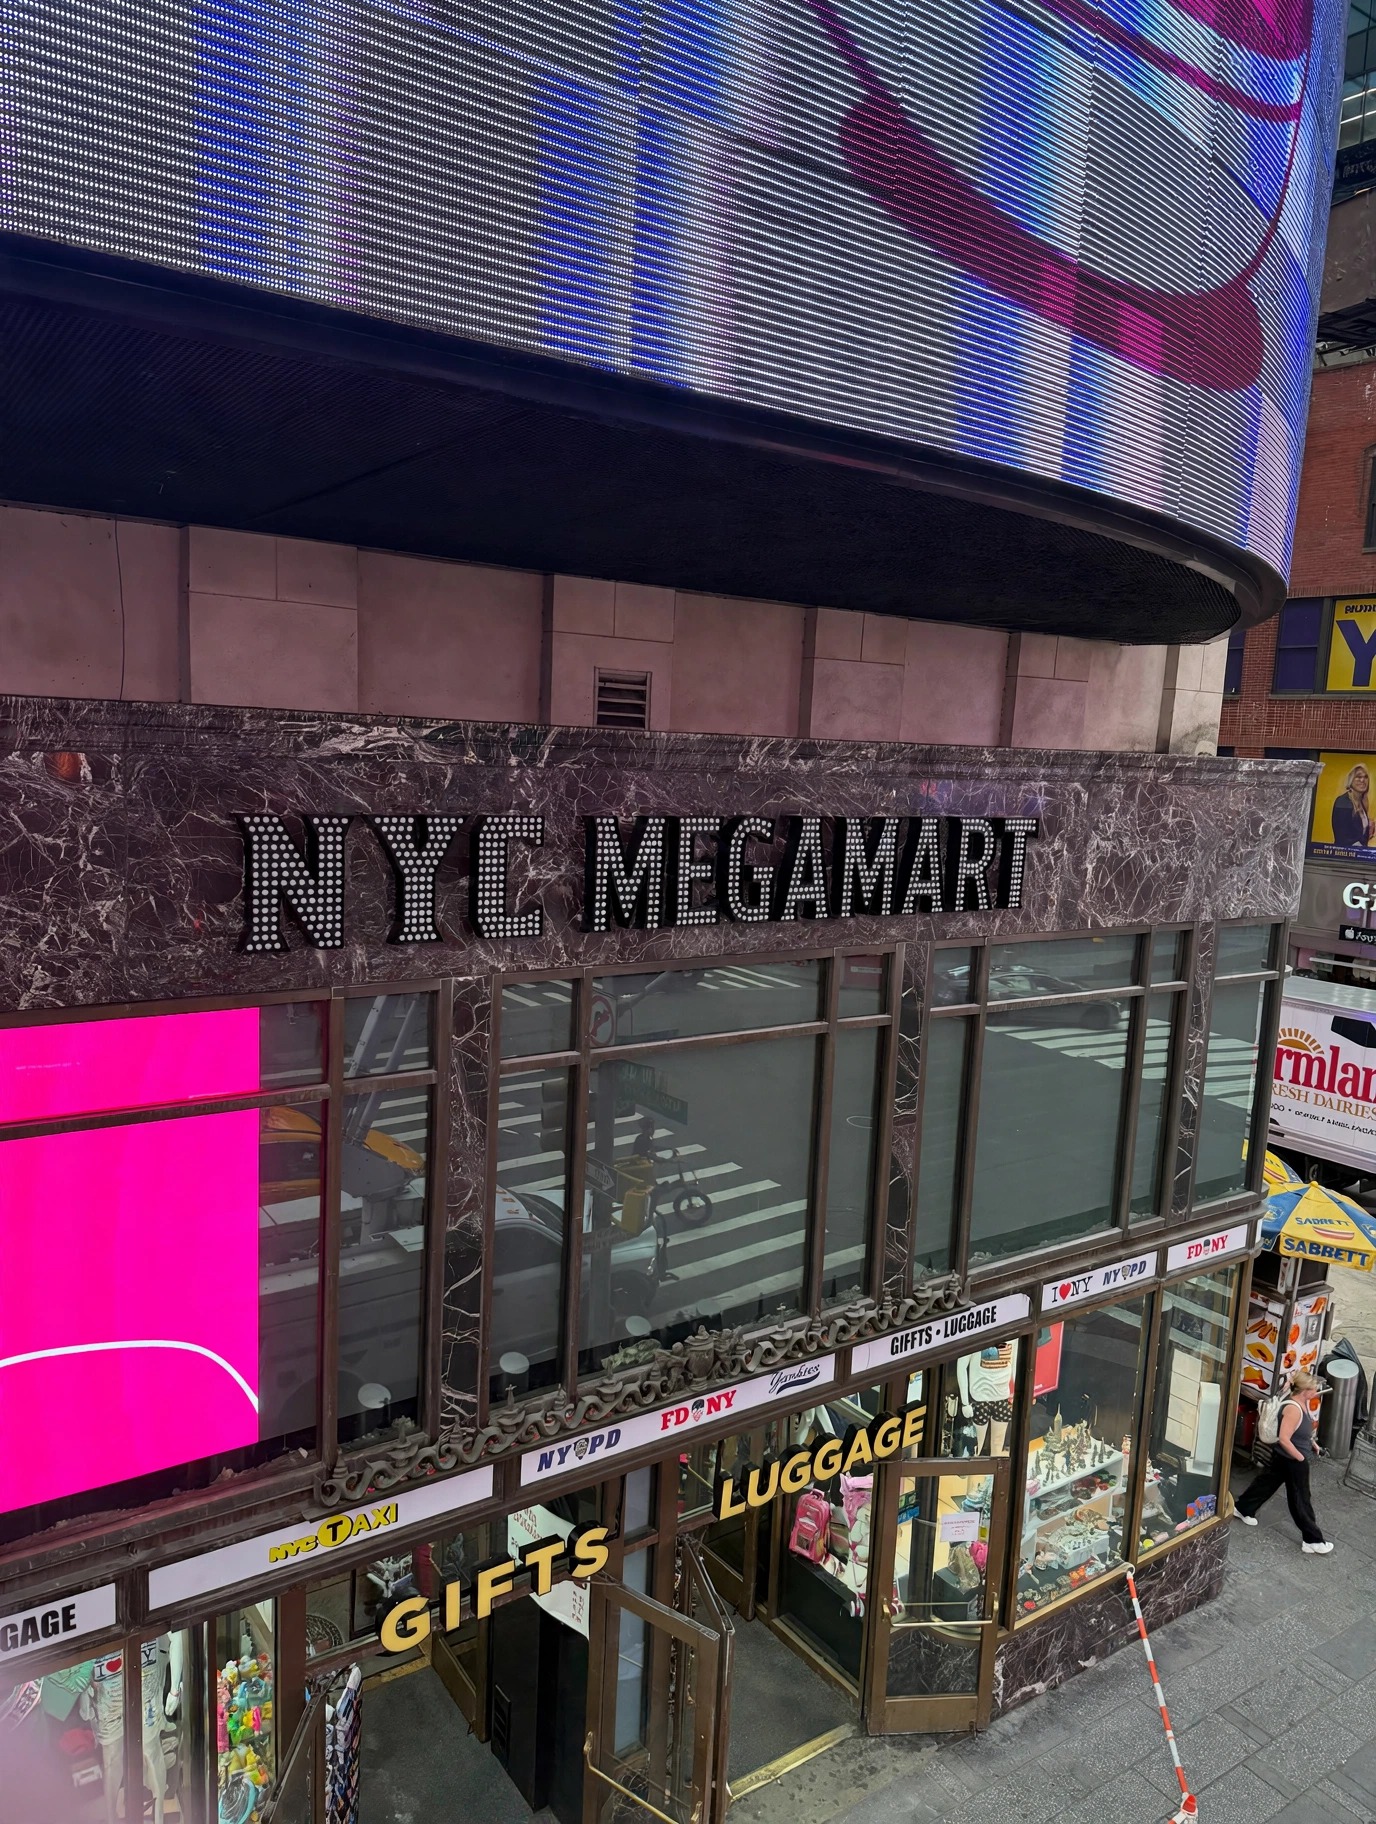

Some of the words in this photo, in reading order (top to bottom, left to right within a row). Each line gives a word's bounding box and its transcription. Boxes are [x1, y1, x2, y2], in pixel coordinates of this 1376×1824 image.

[233, 814, 545, 951] NYC
[582, 815, 1038, 932] MEGAMART
[1283, 1238, 1370, 1267] SABRETT
[890, 1325, 933, 1356] GIFFTS
[943, 1305, 997, 1339] LUGGAGE
[719, 1405, 927, 1521] LUGGAGE
[268, 1535, 318, 1563] NYC
[322, 1503, 398, 1545] TAXI
[379, 1526, 610, 1653] GIFTS
